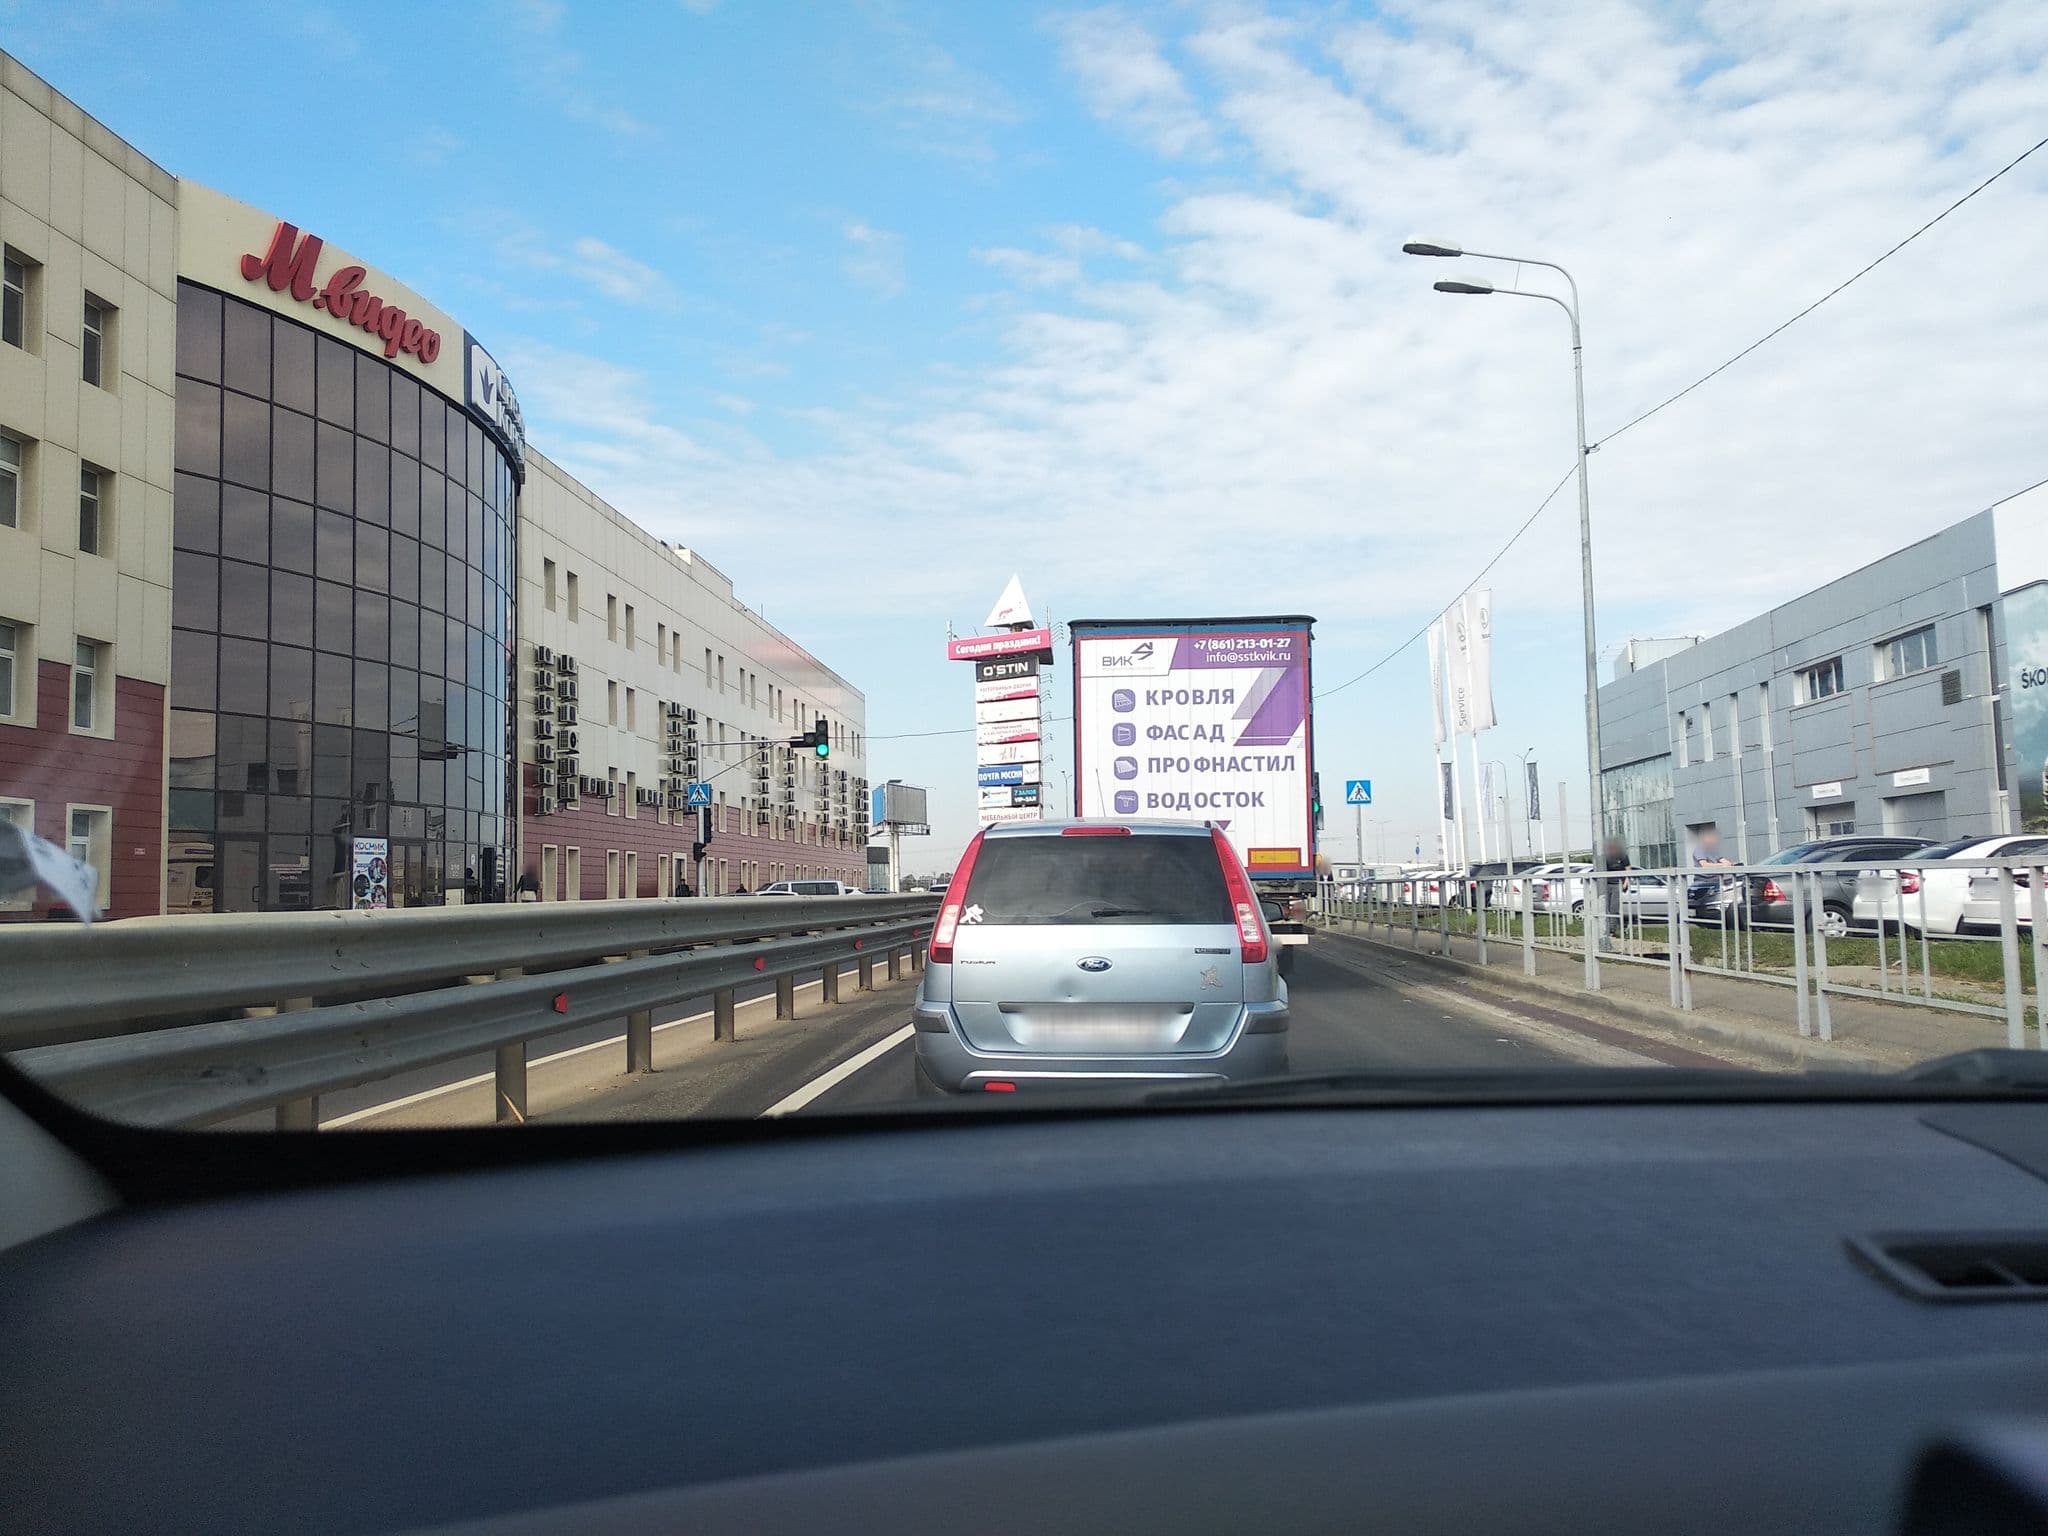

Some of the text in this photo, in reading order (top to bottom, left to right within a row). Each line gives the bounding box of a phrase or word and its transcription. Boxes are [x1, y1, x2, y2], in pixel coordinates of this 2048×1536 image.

[241, 221, 440, 364] М.видео
[955, 643, 992, 654] Сегодня
[1194, 638, 1291, 651] +7 (861) 213-01-27
[1102, 656, 1133, 666] ВИК
[1206, 652, 1291, 663] info@sstkvik.ru
[983, 661, 1029, 676] O'STIN
[2021, 667, 2048, 689] ŠKO
[1146, 688, 1235, 706] КРОВЛЯ
[1458, 687, 1467, 727] Service
[1146, 724, 1225, 743] ФАСАД
[1148, 755, 1296, 773] ПРОФНАСТИЛ
[1147, 791, 1265, 811] ВОДОСТОК
[981, 812, 1038, 821] МЕБЕЛЬНЫЙ ЦЕНТР
